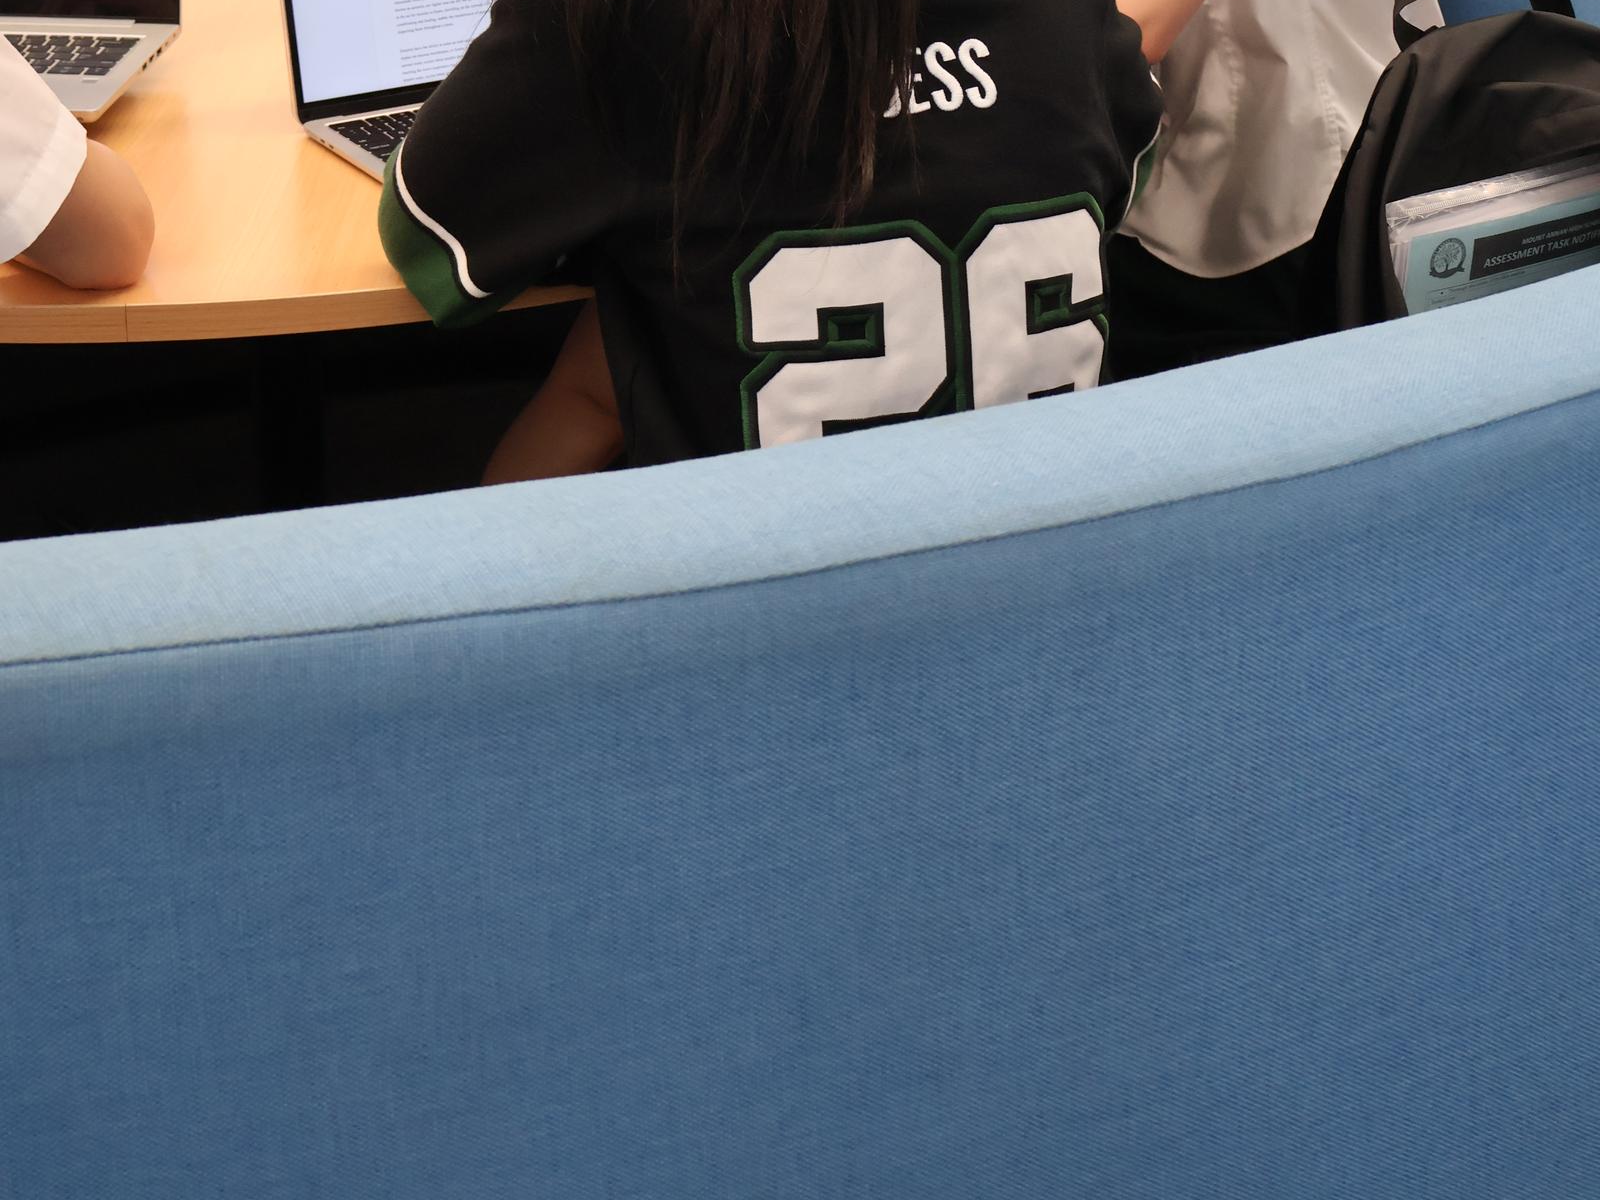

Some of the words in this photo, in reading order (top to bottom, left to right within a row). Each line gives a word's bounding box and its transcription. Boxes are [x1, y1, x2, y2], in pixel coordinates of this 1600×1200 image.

[732, 191, 1111, 451] 26
[1484, 246, 1546, 268] ASSESSMENT
[1547, 239, 1570, 252] TASK
